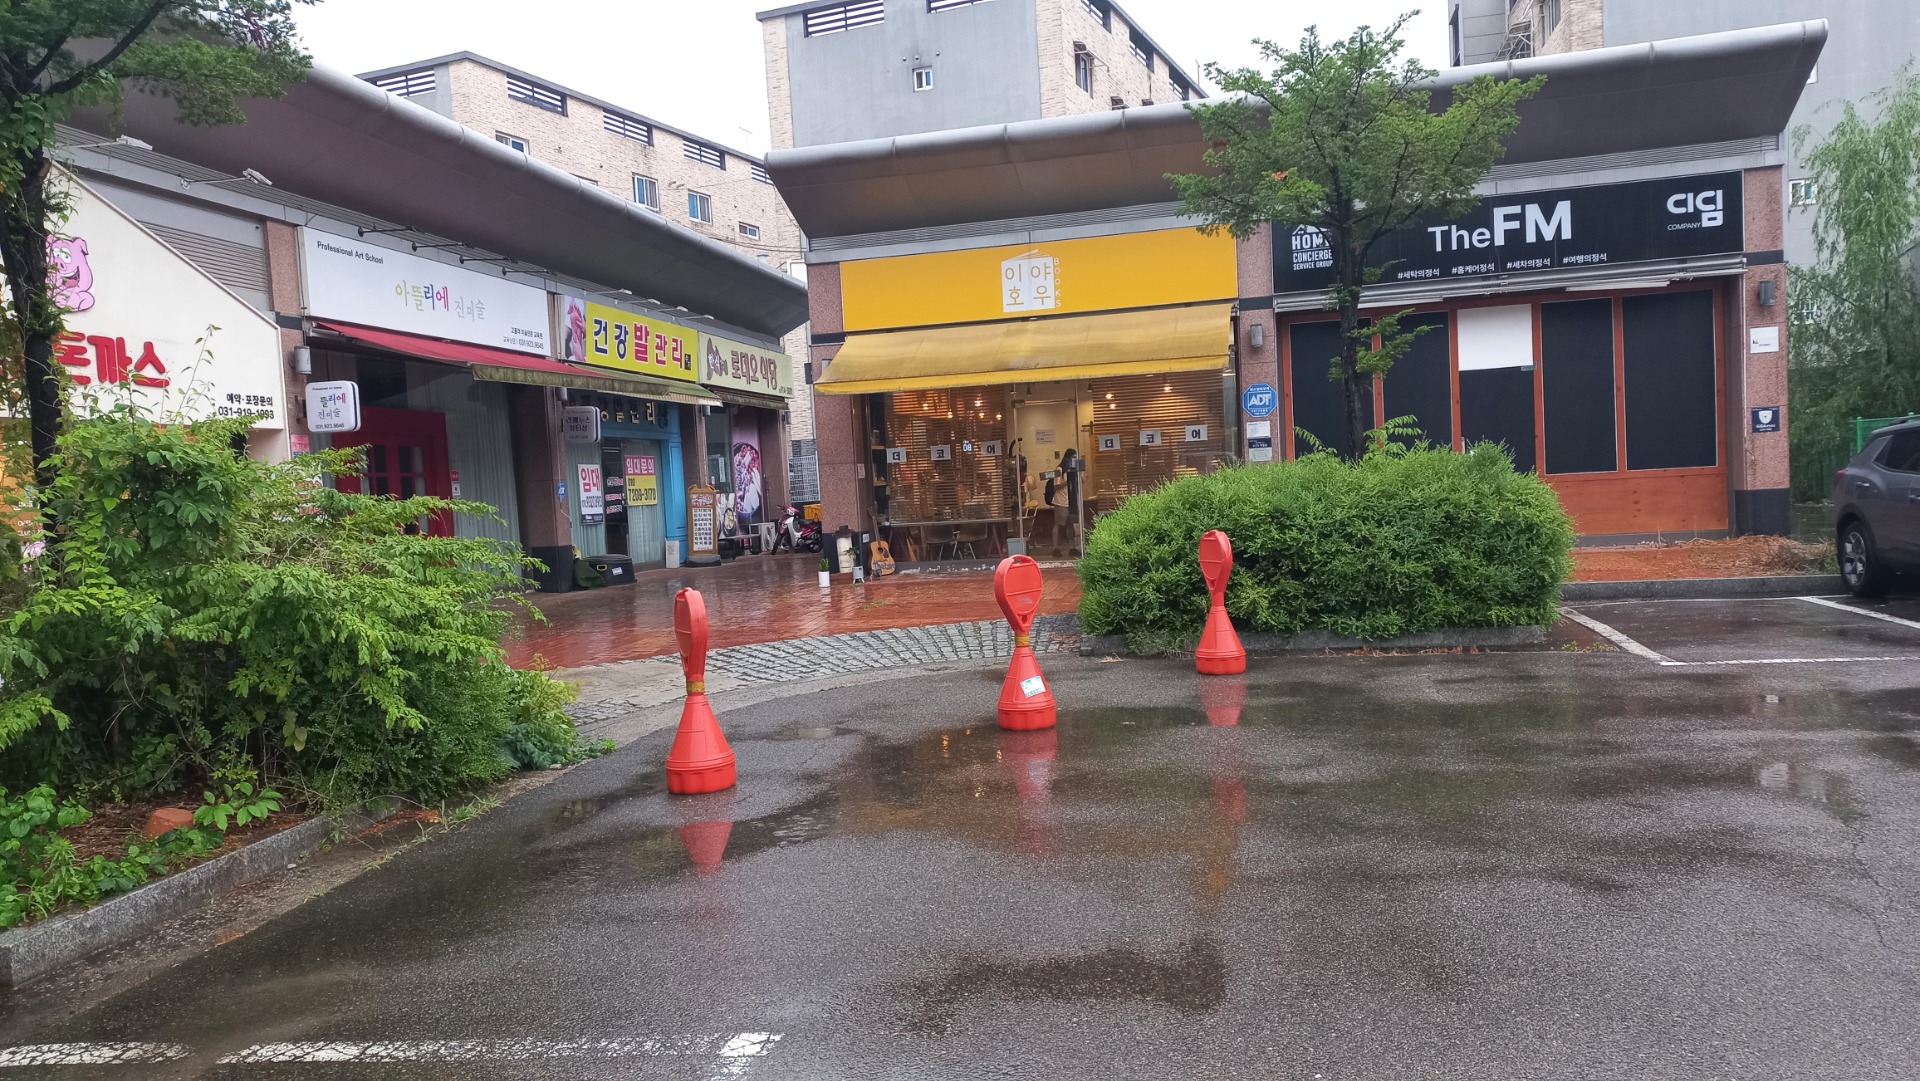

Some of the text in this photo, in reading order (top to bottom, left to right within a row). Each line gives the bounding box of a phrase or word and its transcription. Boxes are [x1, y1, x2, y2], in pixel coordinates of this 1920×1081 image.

[1667, 222, 1701, 231] COMPANY
[316, 240, 385, 265] Professional Art School
[1292, 249, 1333, 263] CONCIERGE
[1293, 261, 1315, 271] SERVICE
[1397, 267, 1440, 280] #세탁의정석
[1506, 257, 1551, 270] #세차의정석
[1562, 252, 1608, 265] #여행의정석
[1052, 257, 1063, 308] BOOKS
[395, 279, 486, 323] 아뜰리에 진미술
[760, 356, 778, 391] 식당
[1249, 395, 1272, 406] ADT
[626, 458, 655, 474] 임대문의
[580, 467, 600, 493] 임대
